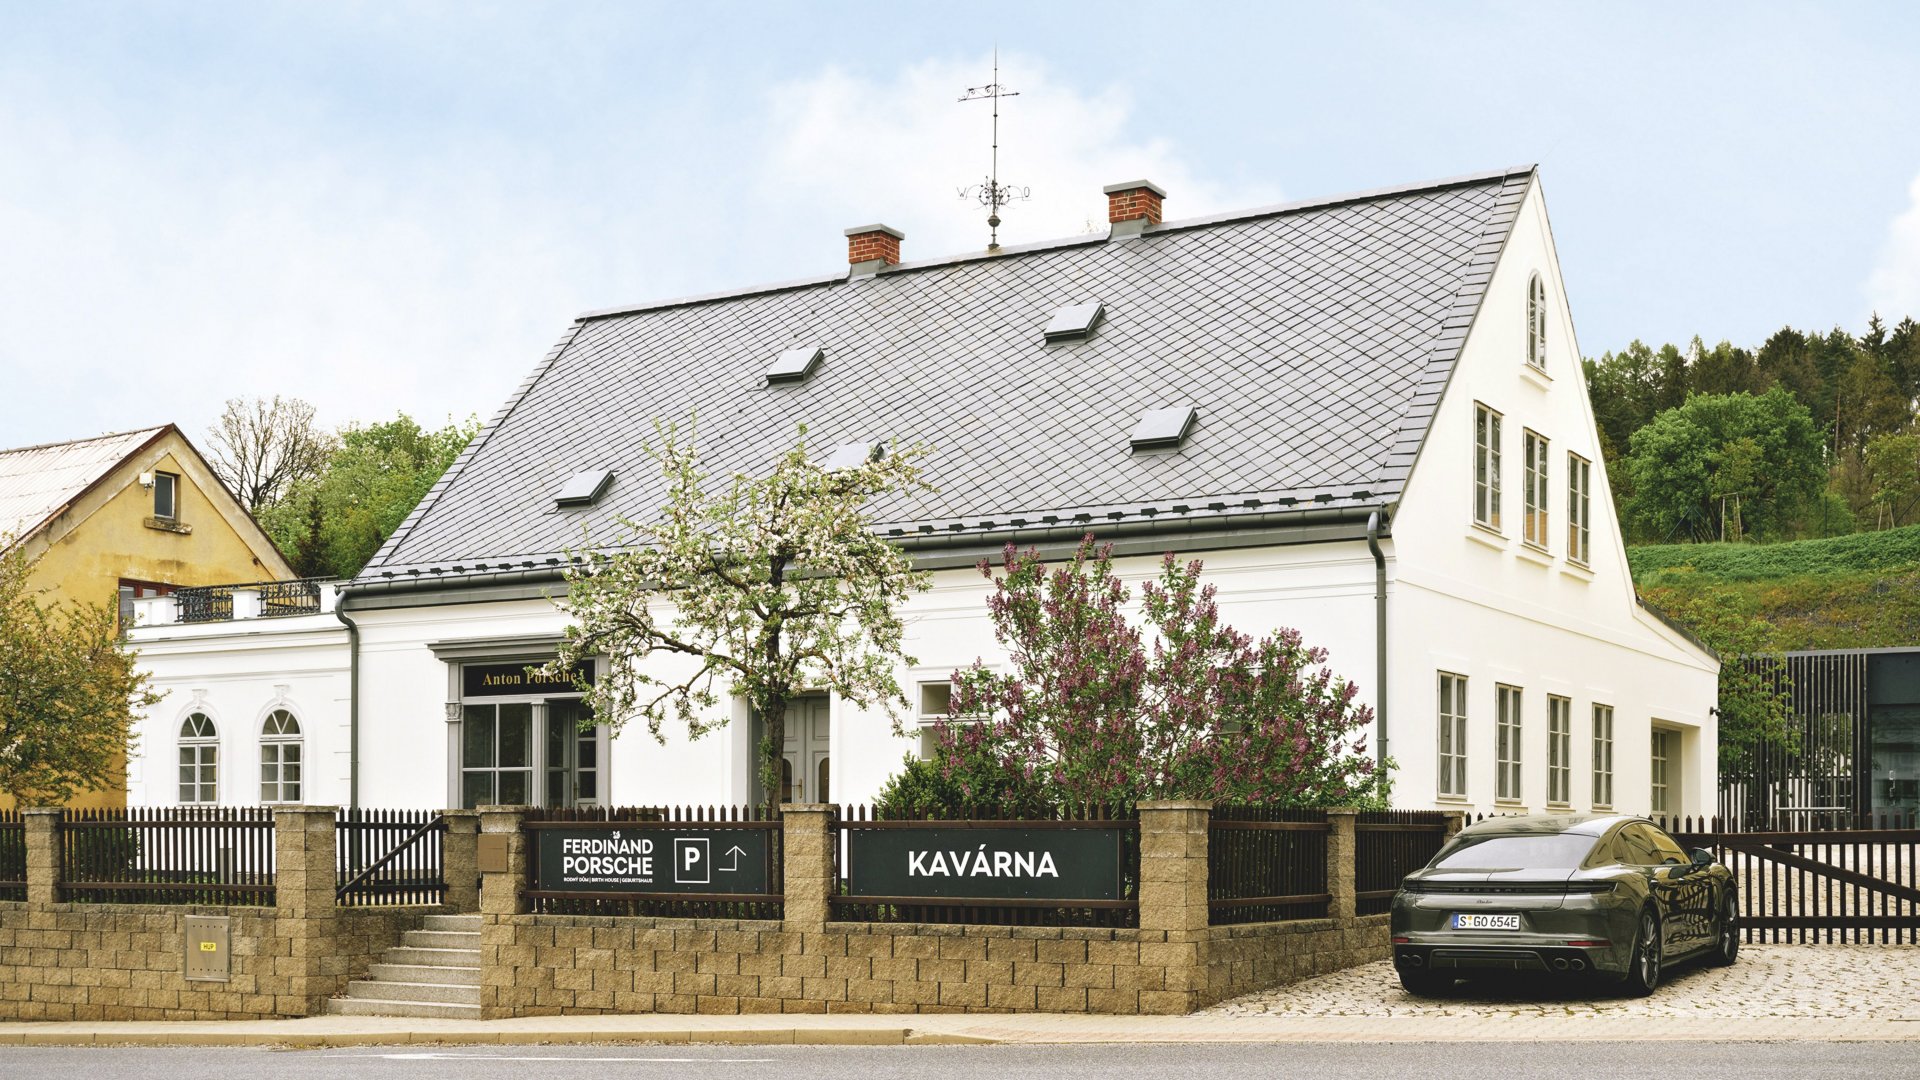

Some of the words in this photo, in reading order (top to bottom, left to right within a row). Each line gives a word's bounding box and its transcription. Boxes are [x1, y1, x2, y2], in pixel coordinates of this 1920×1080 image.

[482, 673, 520, 686] Anton
[526, 671, 577, 684] Porsche
[563, 838, 654, 854] FERDINAND
[563, 856, 654, 875] PORSCHE
[685, 847, 700, 871] P
[908, 844, 1060, 878] KAVÁRNA
[1459, 916, 1467, 927] S
[1473, 916, 1488, 927] GO
[1490, 916, 1518, 928] 654E
